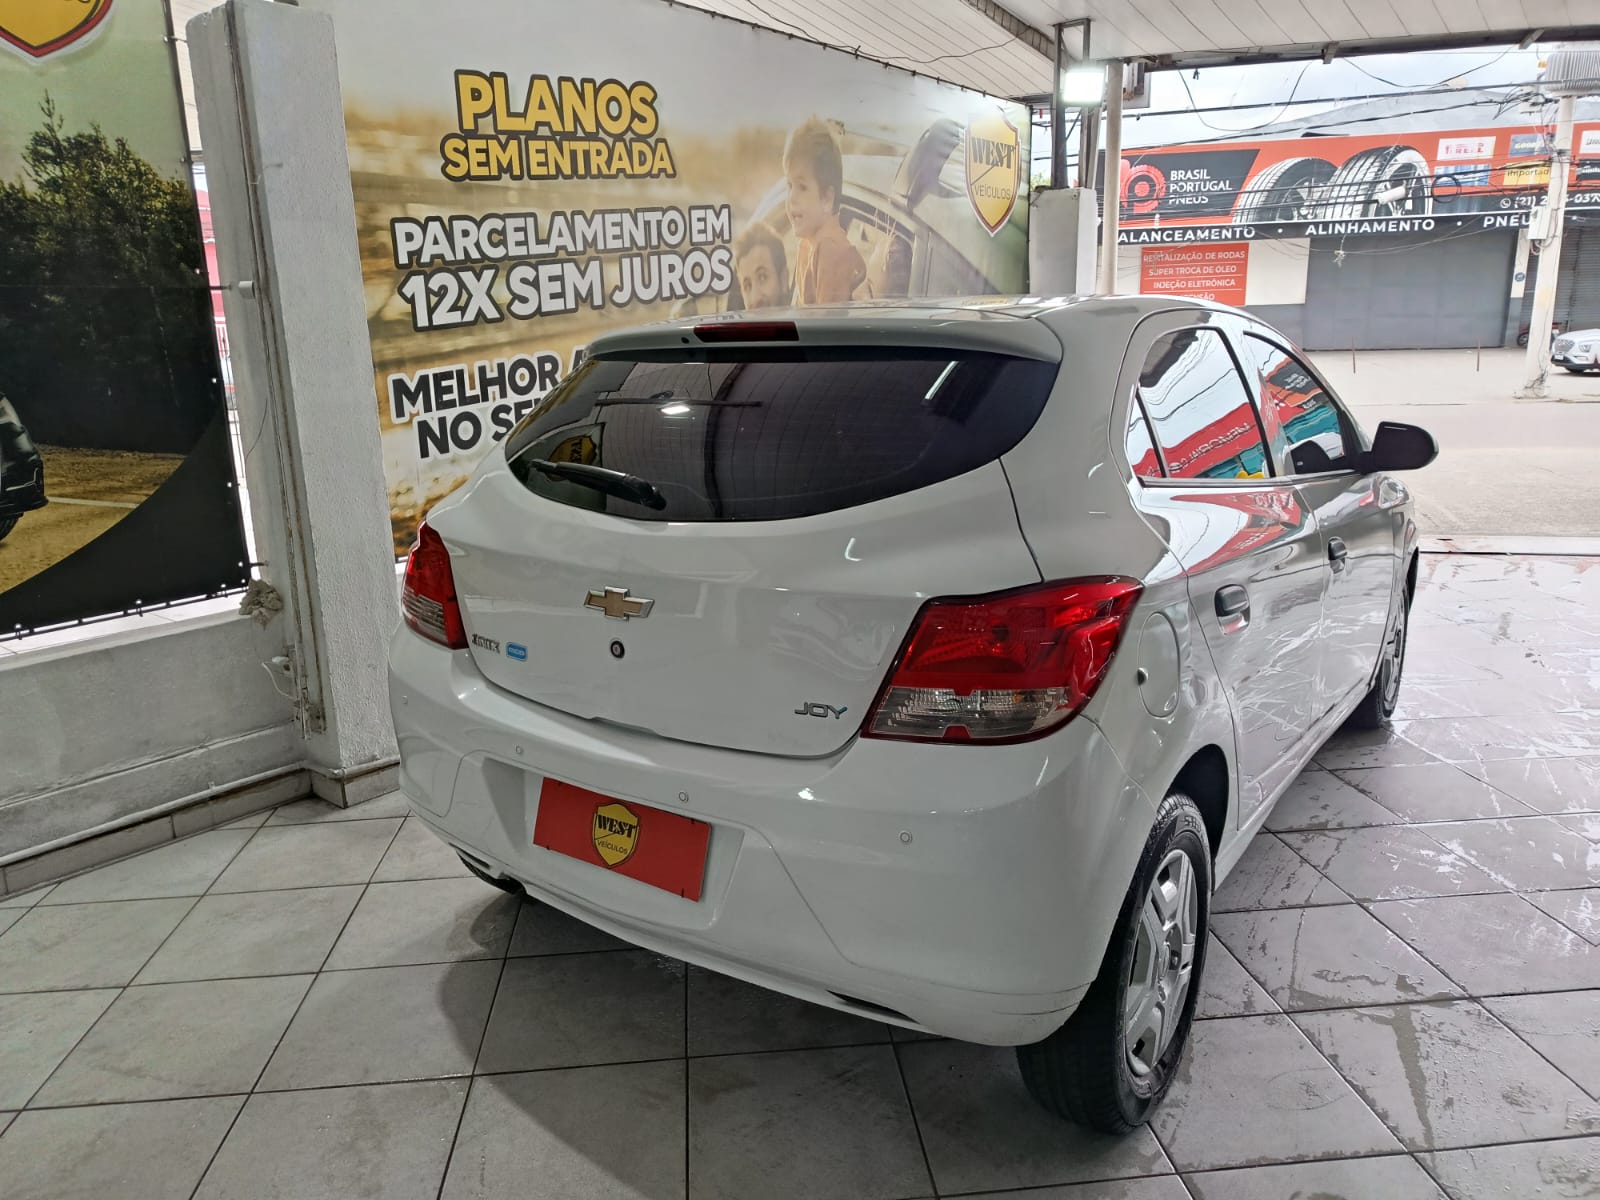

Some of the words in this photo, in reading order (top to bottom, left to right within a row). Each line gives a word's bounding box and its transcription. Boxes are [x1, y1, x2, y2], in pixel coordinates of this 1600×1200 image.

[455, 71, 657, 137] PLANOS
[442, 135, 522, 179] SEM
[526, 136, 675, 178] ENTRADA
[971, 137, 1016, 169] WEST
[1170, 169, 1210, 181] BRASIL
[1507, 168, 1549, 177] importad
[974, 183, 1012, 200] VEÍCULOS
[1169, 180, 1232, 193] PORTUGAL
[1168, 194, 1209, 205] PNEUS
[393, 207, 685, 266] PARCELAMENTO
[690, 206, 731, 244] EM
[1118, 226, 1256, 243] ALANCEAMENTO
[1305, 218, 1435, 236] ALINHAMENTO
[1483, 213, 1531, 228] PNEU
[1205, 252, 1216, 260] DE
[1217, 250, 1245, 259] RODAS
[1176, 266, 1201, 275] TROCA
[1203, 265, 1214, 274] DE
[400, 267, 502, 329] 12X
[506, 259, 603, 318] SEM
[610, 248, 733, 305] JUROS
[1153, 279, 1186, 290] INJEÇÃO
[1188, 279, 1236, 288] ELETRÔNICA
[391, 354, 560, 419] MELHOR
[417, 411, 482, 460] NO
[491, 398, 541, 442] SE
[794, 701, 848, 720] JOY
[596, 814, 637, 838] WEST
